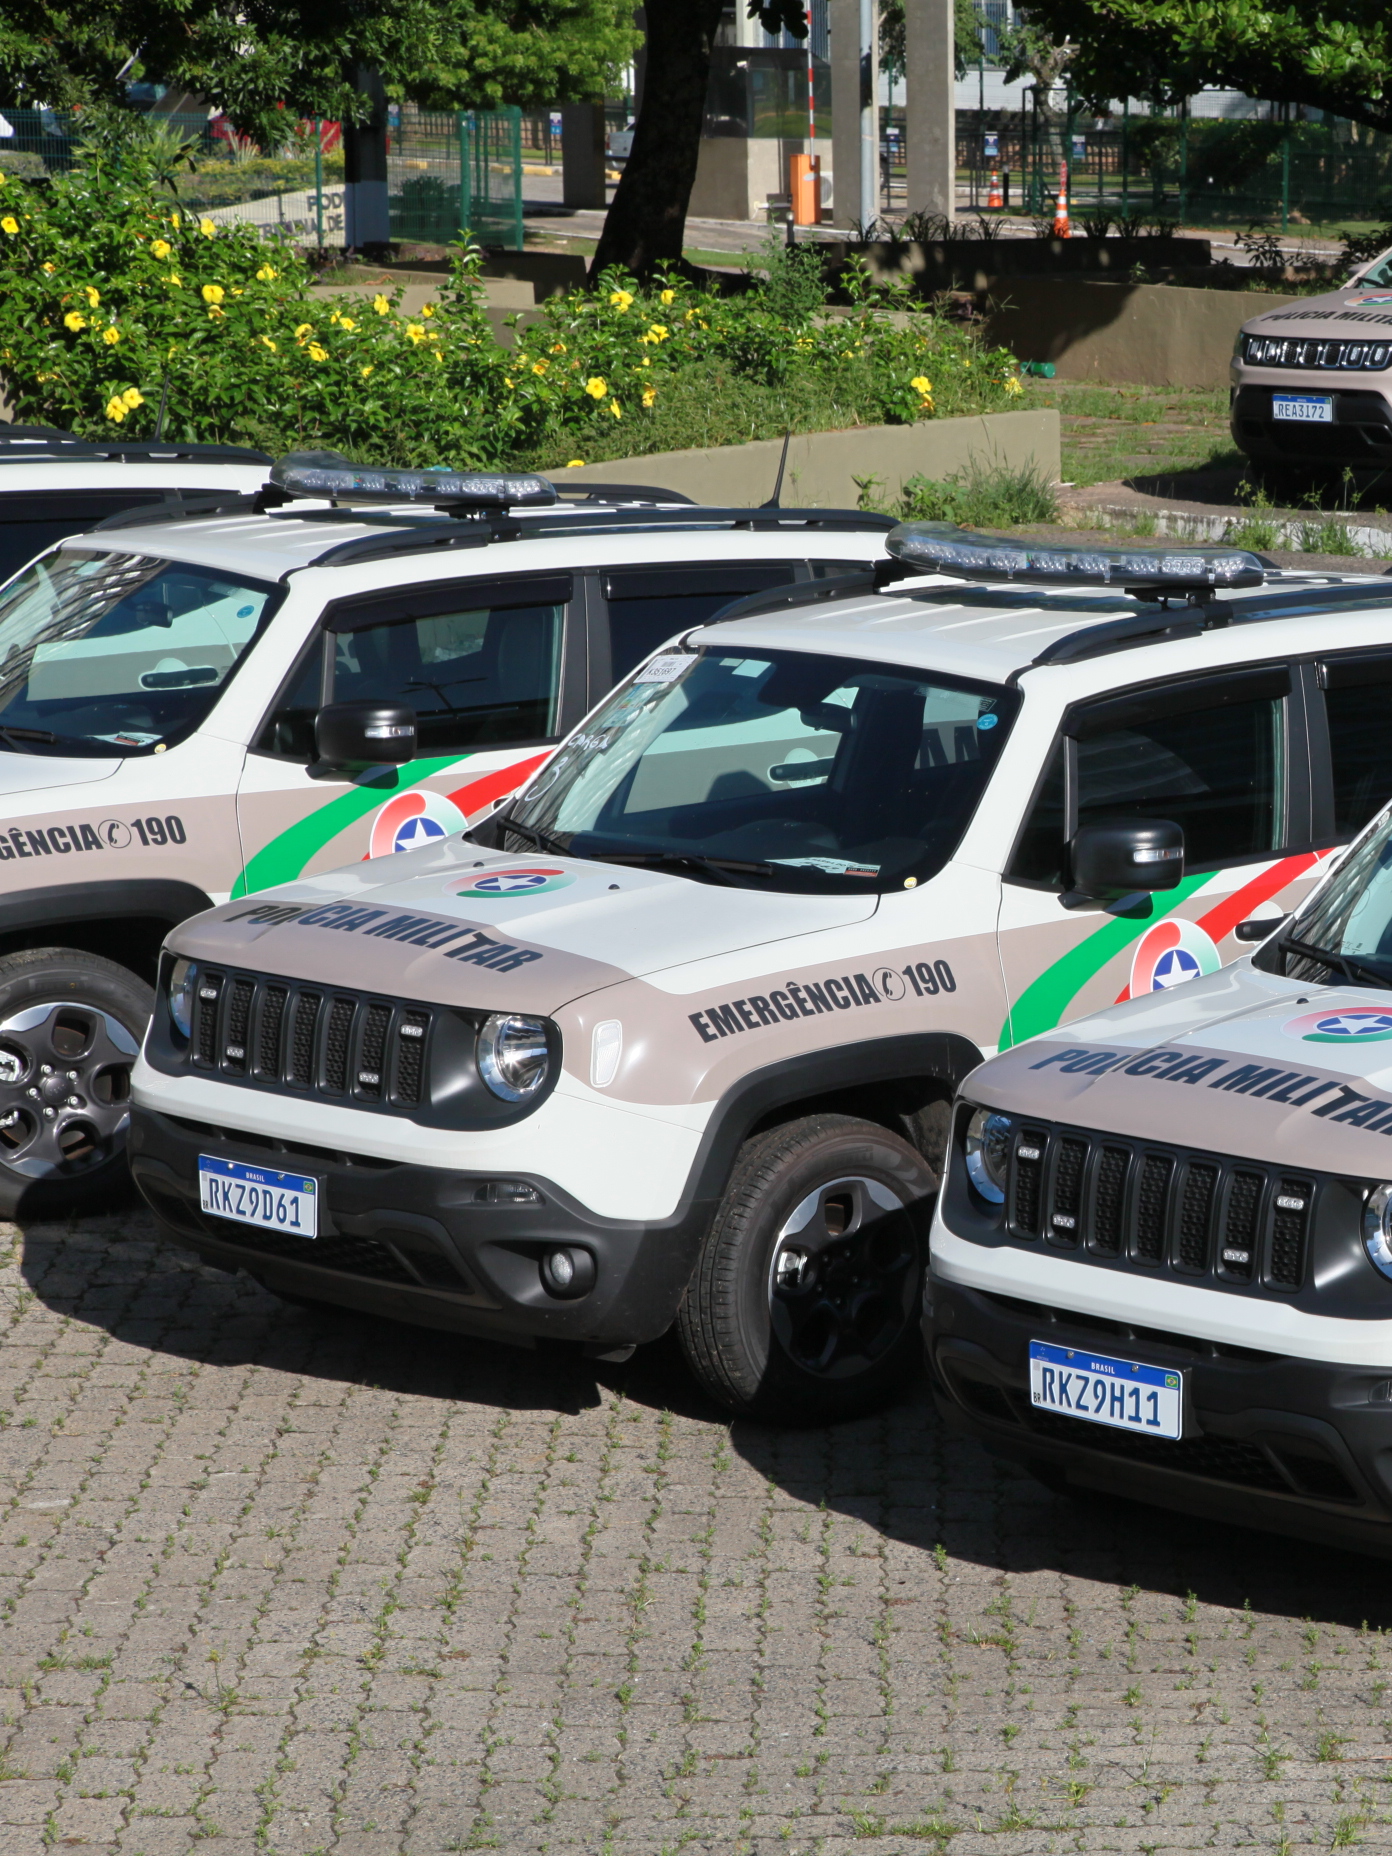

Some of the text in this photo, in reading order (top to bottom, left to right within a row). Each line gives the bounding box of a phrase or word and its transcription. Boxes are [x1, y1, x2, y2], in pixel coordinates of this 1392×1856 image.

[306, 192, 345, 212] POD
[1261, 309, 1336, 322] POLÍCIA
[131, 815, 187, 846] 190
[362, 914, 544, 973] MILITAR
[688, 959, 957, 1043] EMERGÊNCIA 190
[1028, 1046, 1230, 1085] POLÍCIA
[246, 1171, 265, 1183] BRASIL
[209, 1177, 301, 1228] RKZ9D61
[1091, 1361, 1116, 1375] BRASIL
[1042, 1366, 1161, 1428] RKZ9H11
